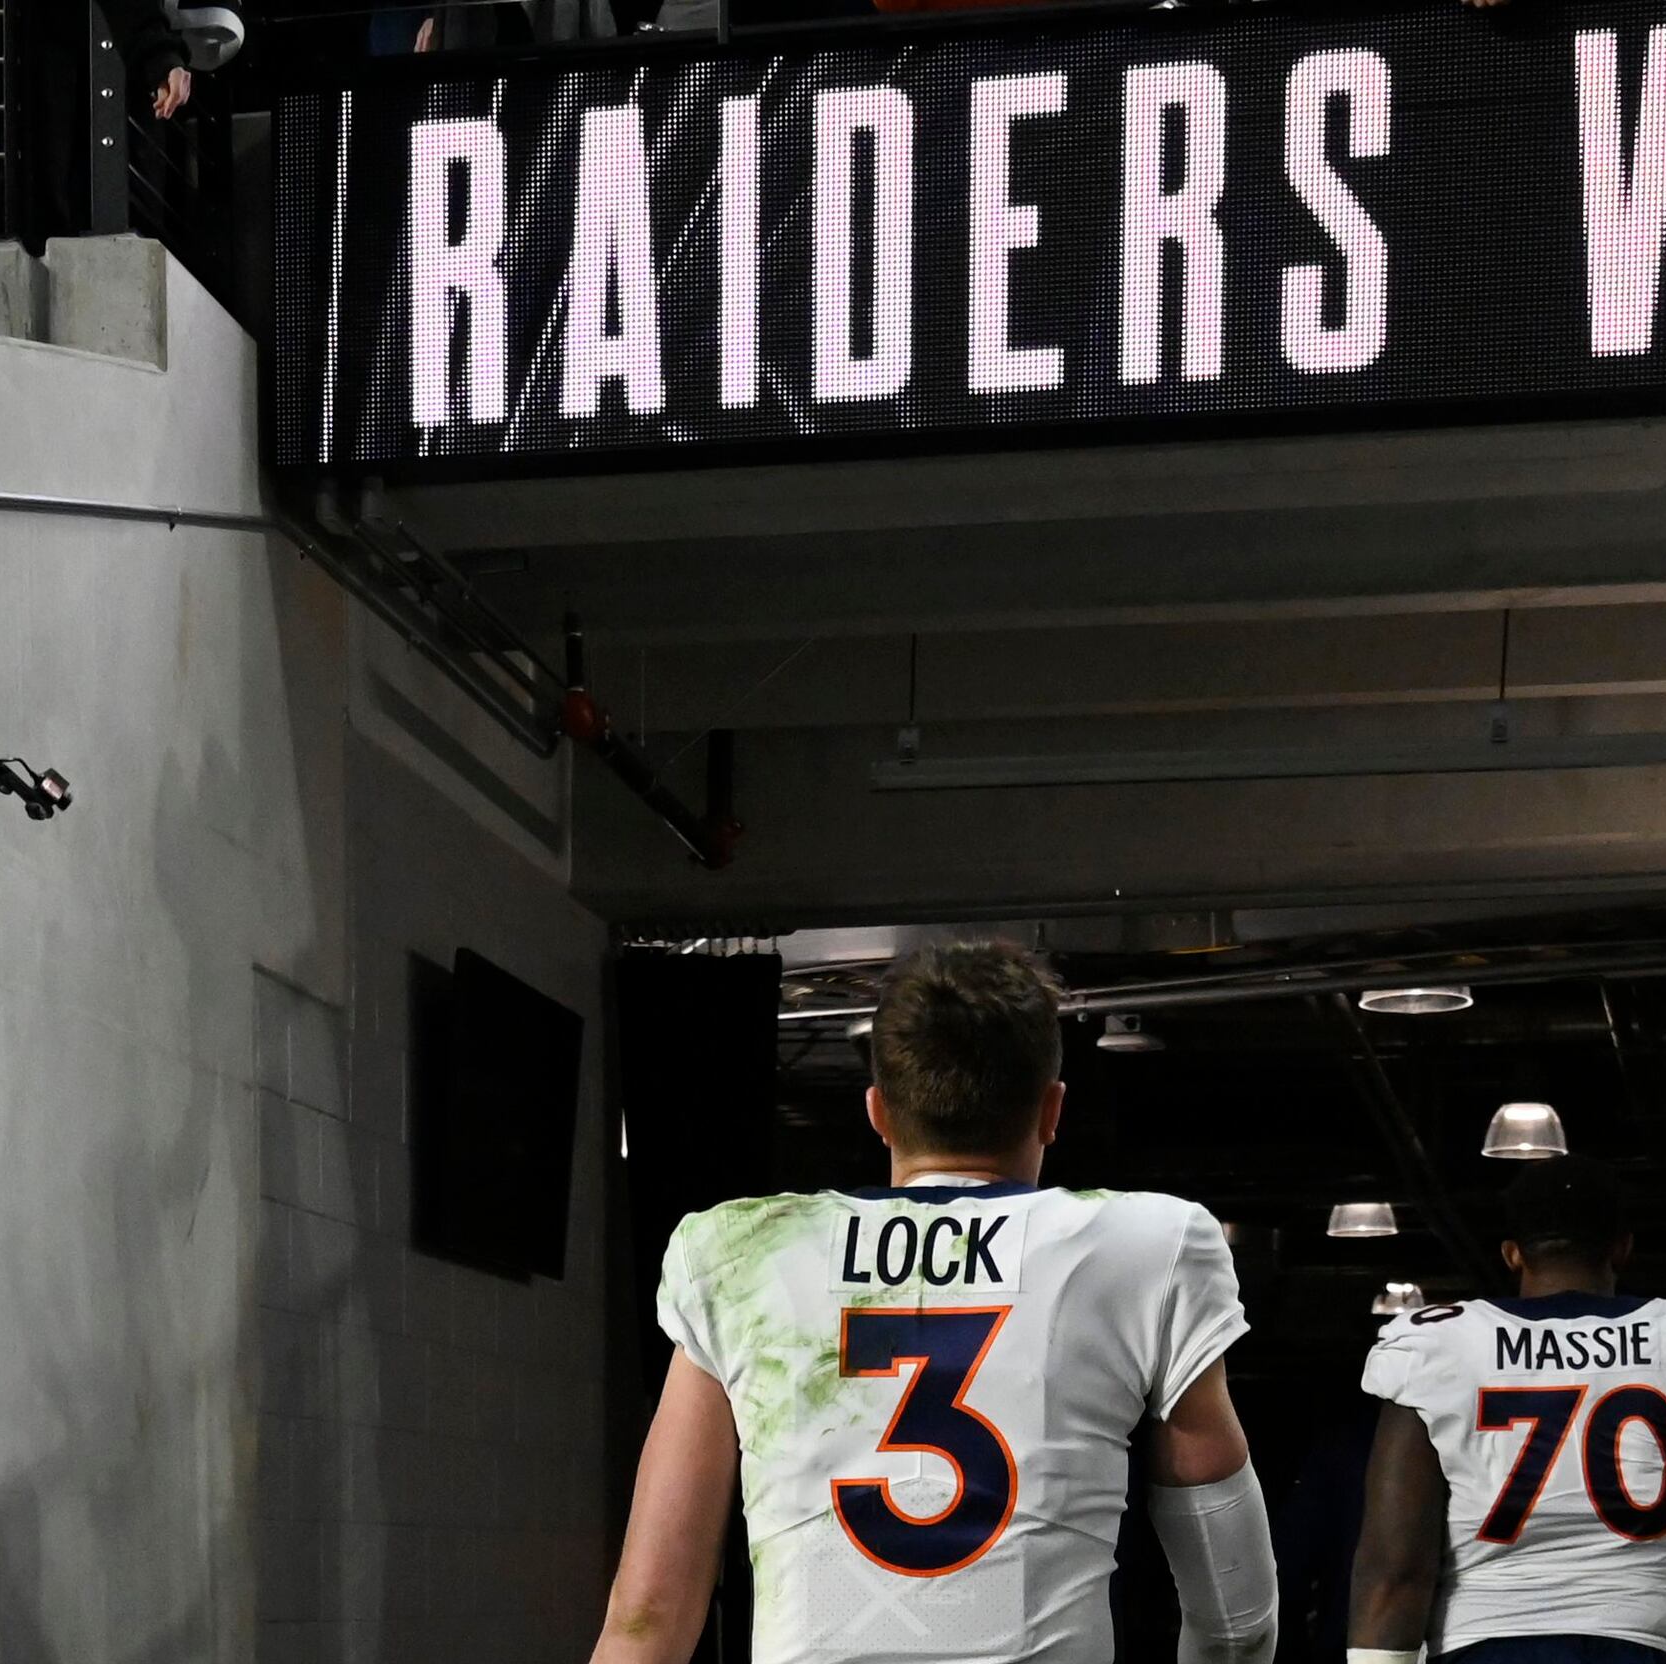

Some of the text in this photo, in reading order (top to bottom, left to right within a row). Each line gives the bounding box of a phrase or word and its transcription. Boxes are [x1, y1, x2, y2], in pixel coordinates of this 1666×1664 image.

[409, 48, 1391, 427] RAIDERS
[842, 1214, 1009, 1286] LOCK
[1496, 1322, 1651, 1370] MASSIE
[830, 1305, 1018, 1578] 3
